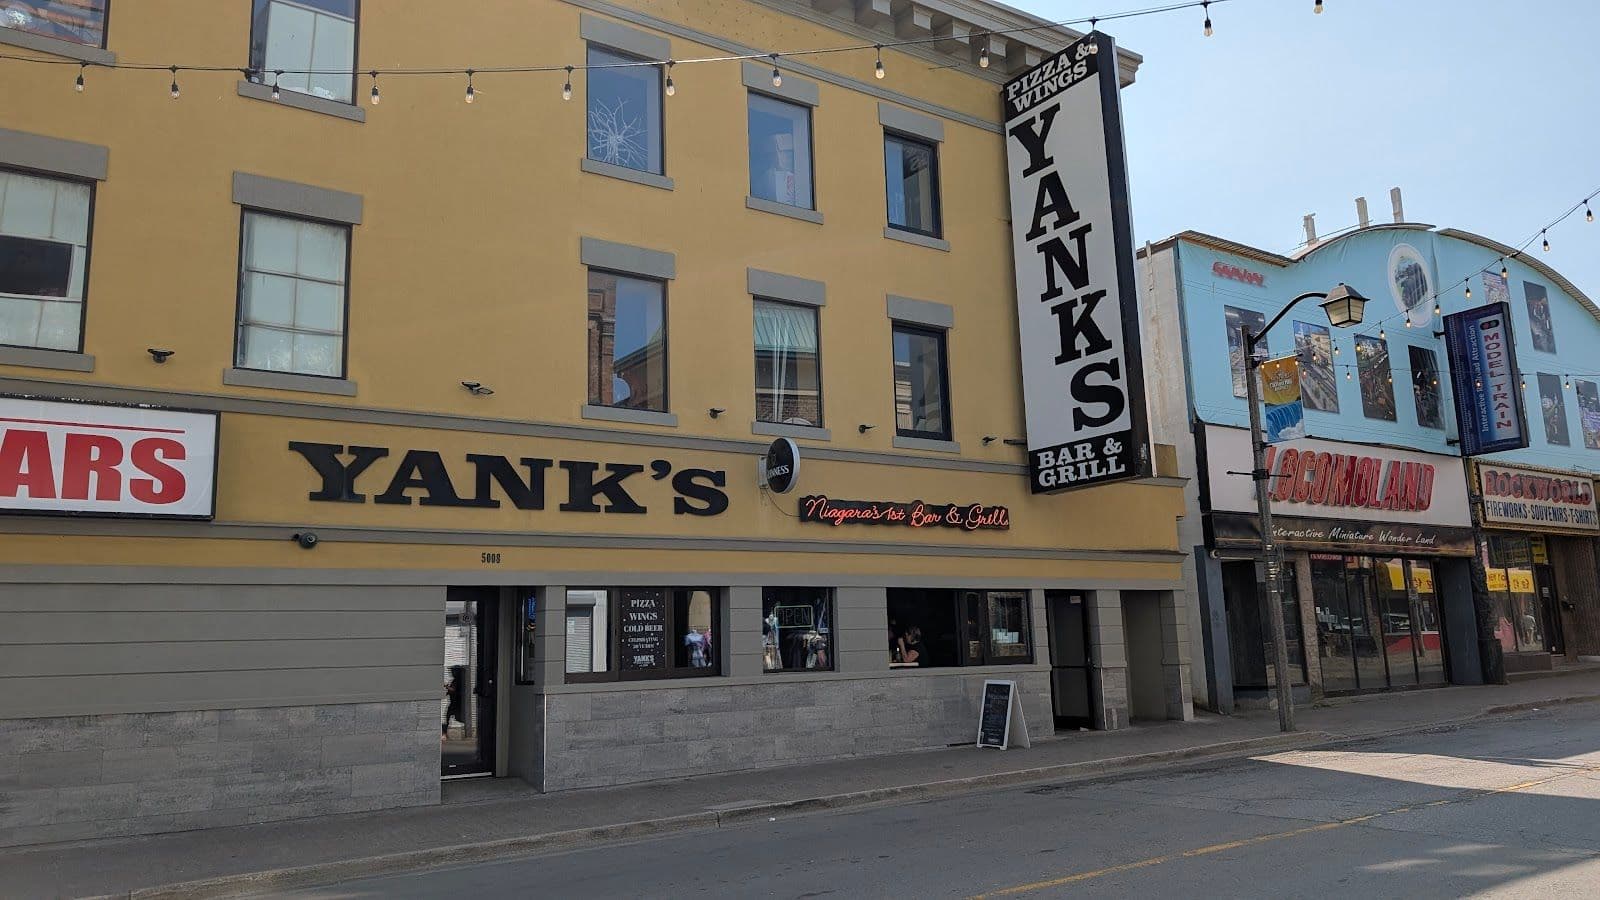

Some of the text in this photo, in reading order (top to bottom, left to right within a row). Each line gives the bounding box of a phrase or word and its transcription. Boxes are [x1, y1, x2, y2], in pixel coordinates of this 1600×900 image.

[1007, 43, 1092, 101] PIZZA &
[1012, 60, 1087, 113] WINGS
[1009, 102, 1125, 432] YANKS
[1469, 324, 1489, 432] Interactive Rlroad Attraction
[1484, 333, 1512, 429] MODEL TRAIN
[0, 428, 186, 505] ARS
[1037, 442, 1095, 469] BAR
[1103, 437, 1122, 455] &
[288, 440, 730, 517] YANK'S
[1038, 456, 1125, 487] GRILL
[1484, 470, 1593, 506] ROCKWORLD
[806, 497, 879, 527] Niagara's
[911, 504, 941, 527] Bar
[945, 504, 963, 524] &
[965, 504, 1009, 530] Grill
[1486, 500, 1528, 519] FIREWORKS
[1272, 524, 1435, 545] nteractive Miniature Wonder Land
[629, 612, 658, 621] WINGS
[631, 599, 656, 608] PIZZA
[623, 624, 663, 633] COLD BEER
